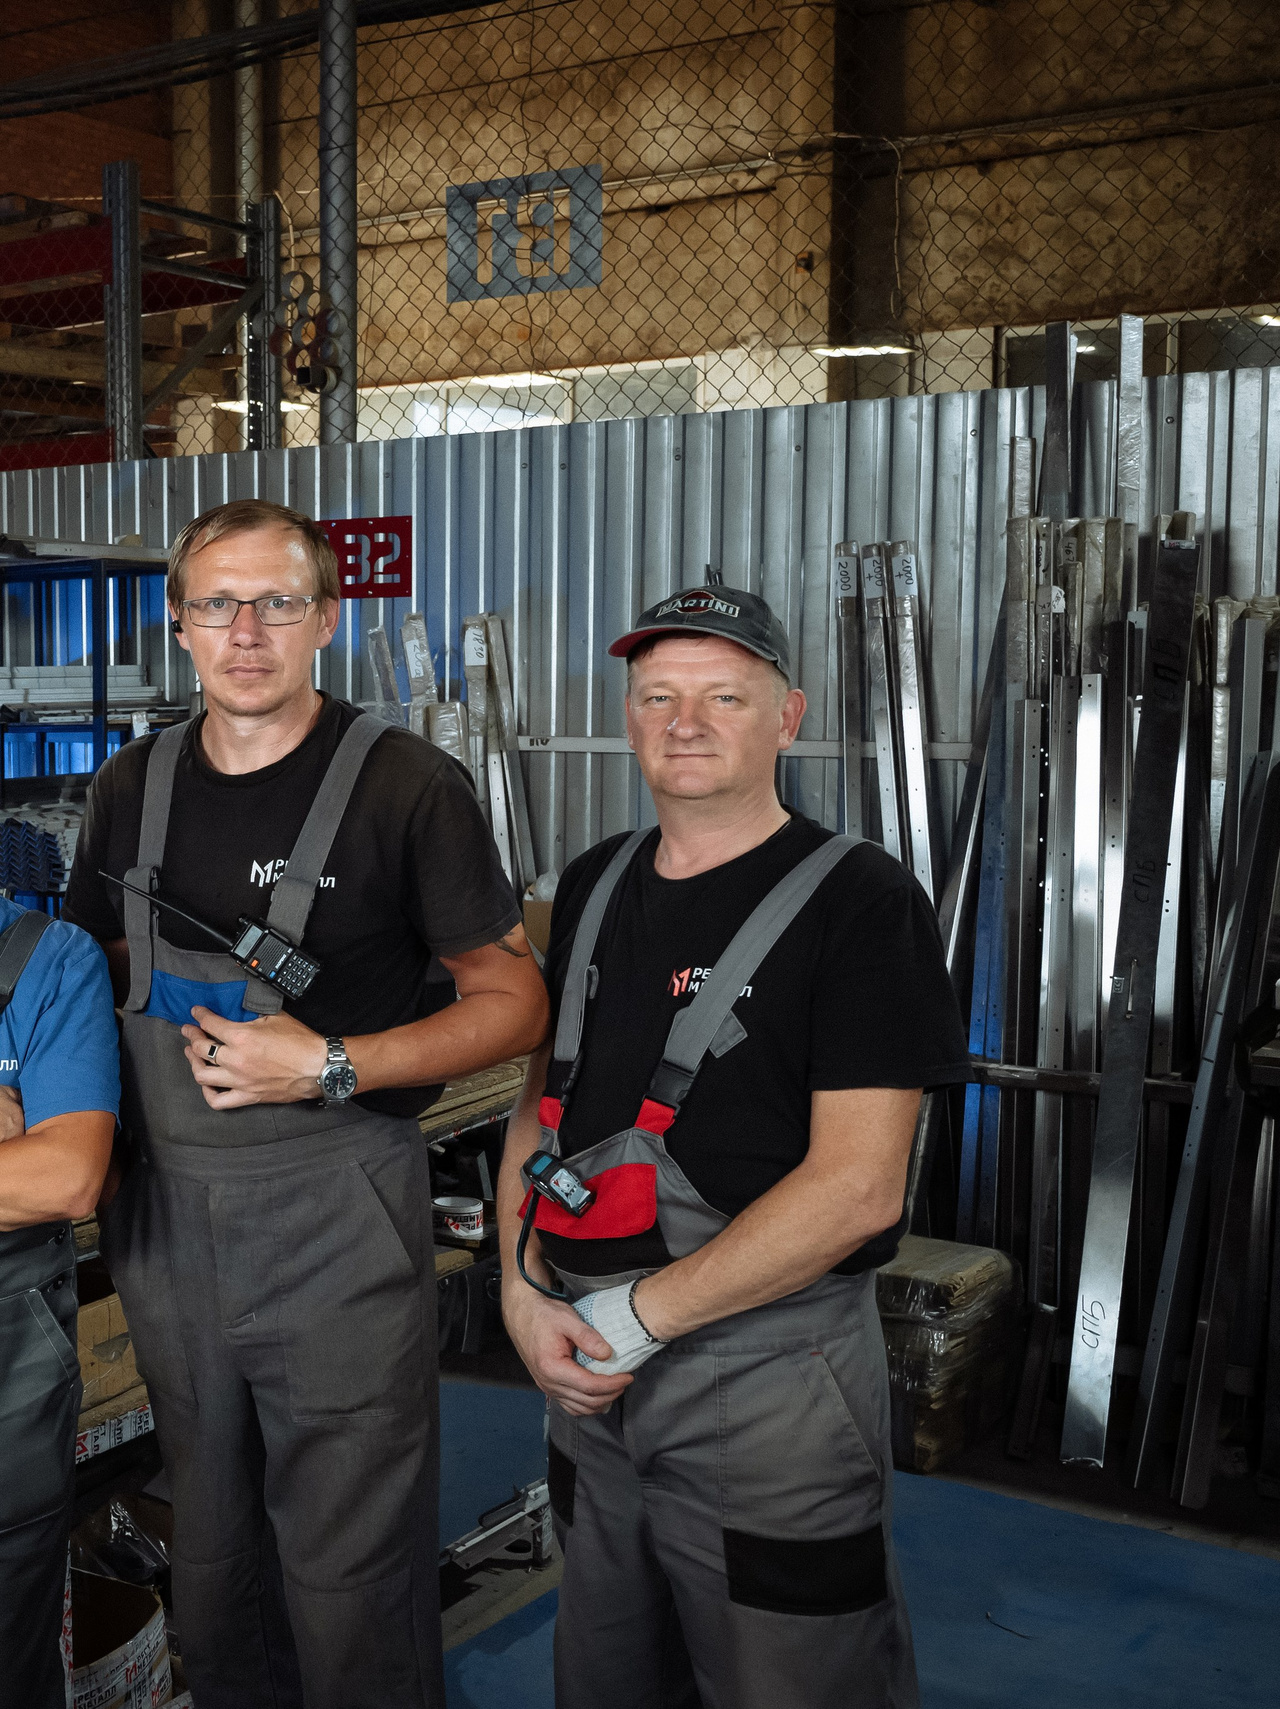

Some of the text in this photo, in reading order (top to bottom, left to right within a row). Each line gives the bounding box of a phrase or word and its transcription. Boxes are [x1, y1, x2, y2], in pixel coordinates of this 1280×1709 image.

[324, 532, 401, 585] 32
[872, 559, 883, 587] 2000
[901, 557, 914, 585] 2000
[838, 561, 851, 591] 2000
[660, 599, 734, 615] MARTINI
[1081, 1294, 1106, 1349] СПБ
